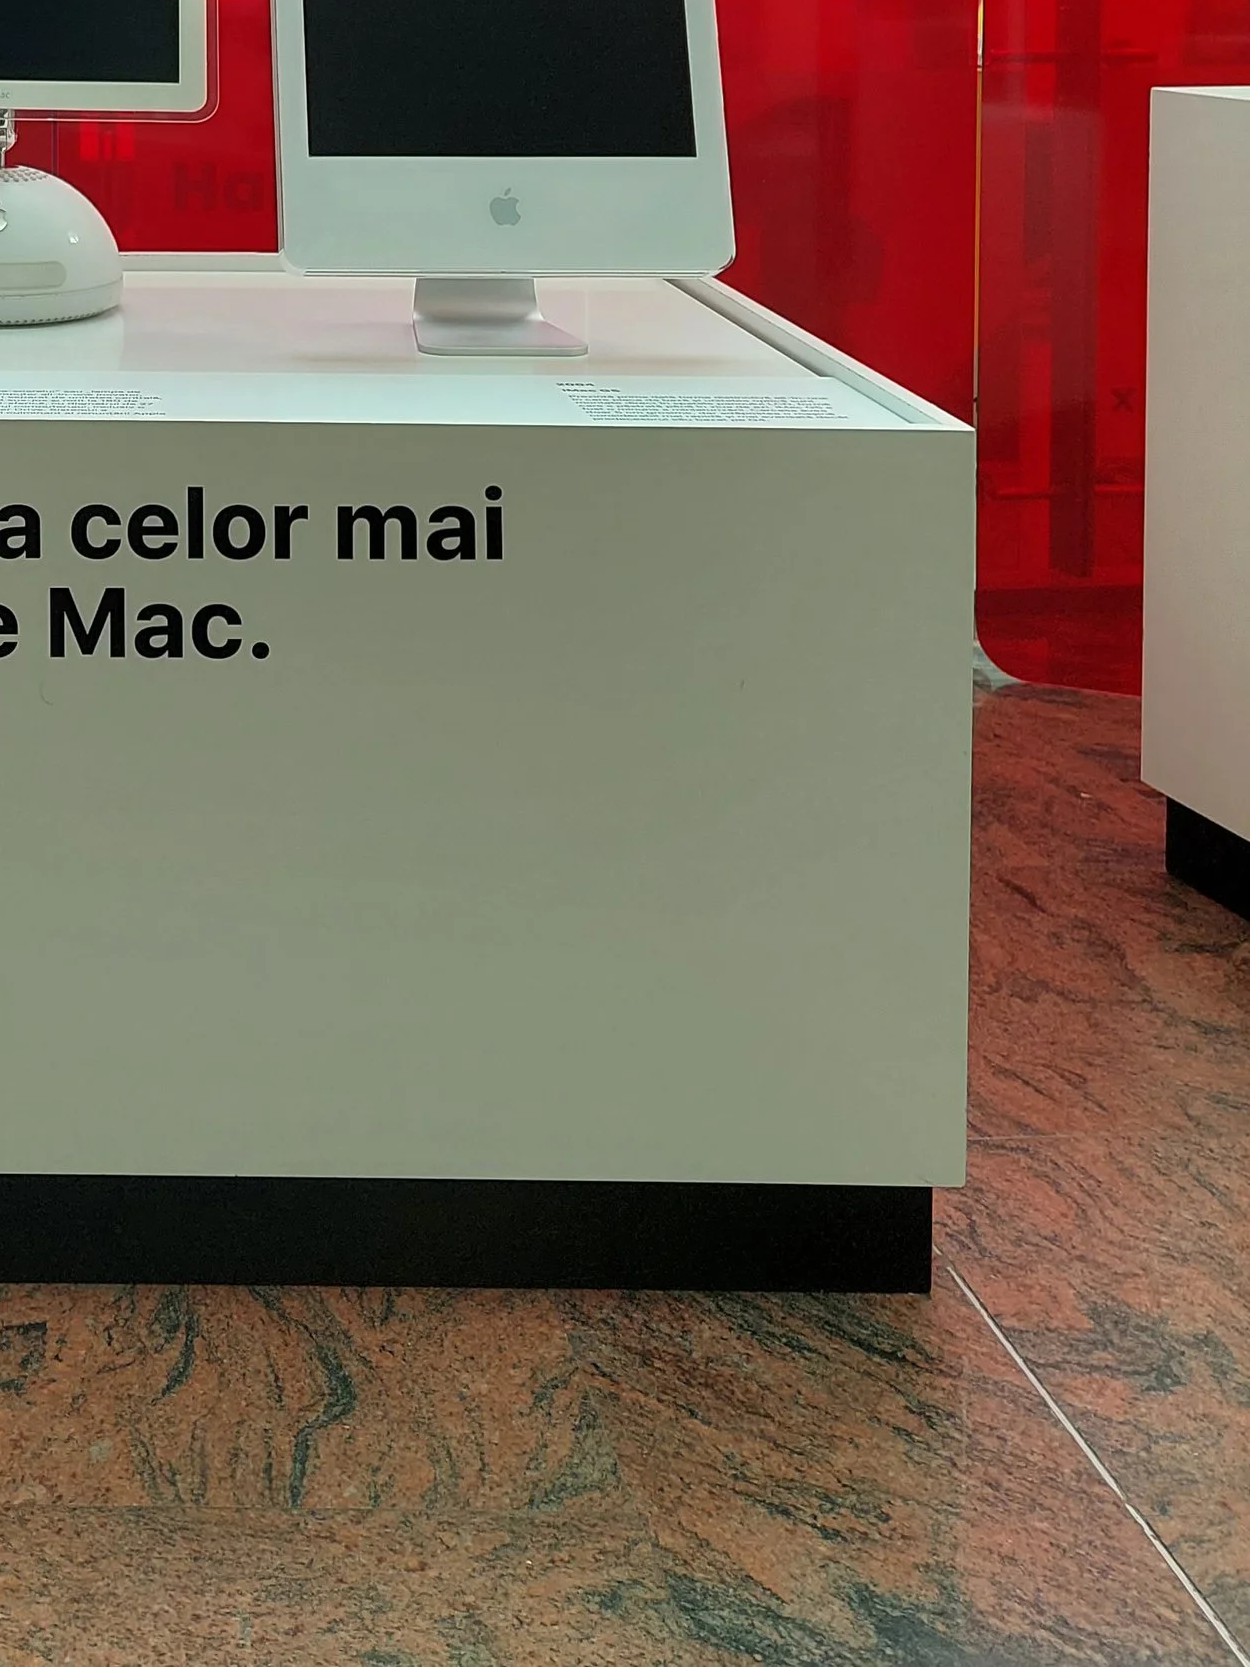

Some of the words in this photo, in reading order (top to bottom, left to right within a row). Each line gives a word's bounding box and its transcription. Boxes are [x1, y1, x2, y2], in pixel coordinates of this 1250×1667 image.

[69, 486, 308, 562] celor
[337, 486, 507, 562] mai
[48, 586, 273, 661] Mac.
